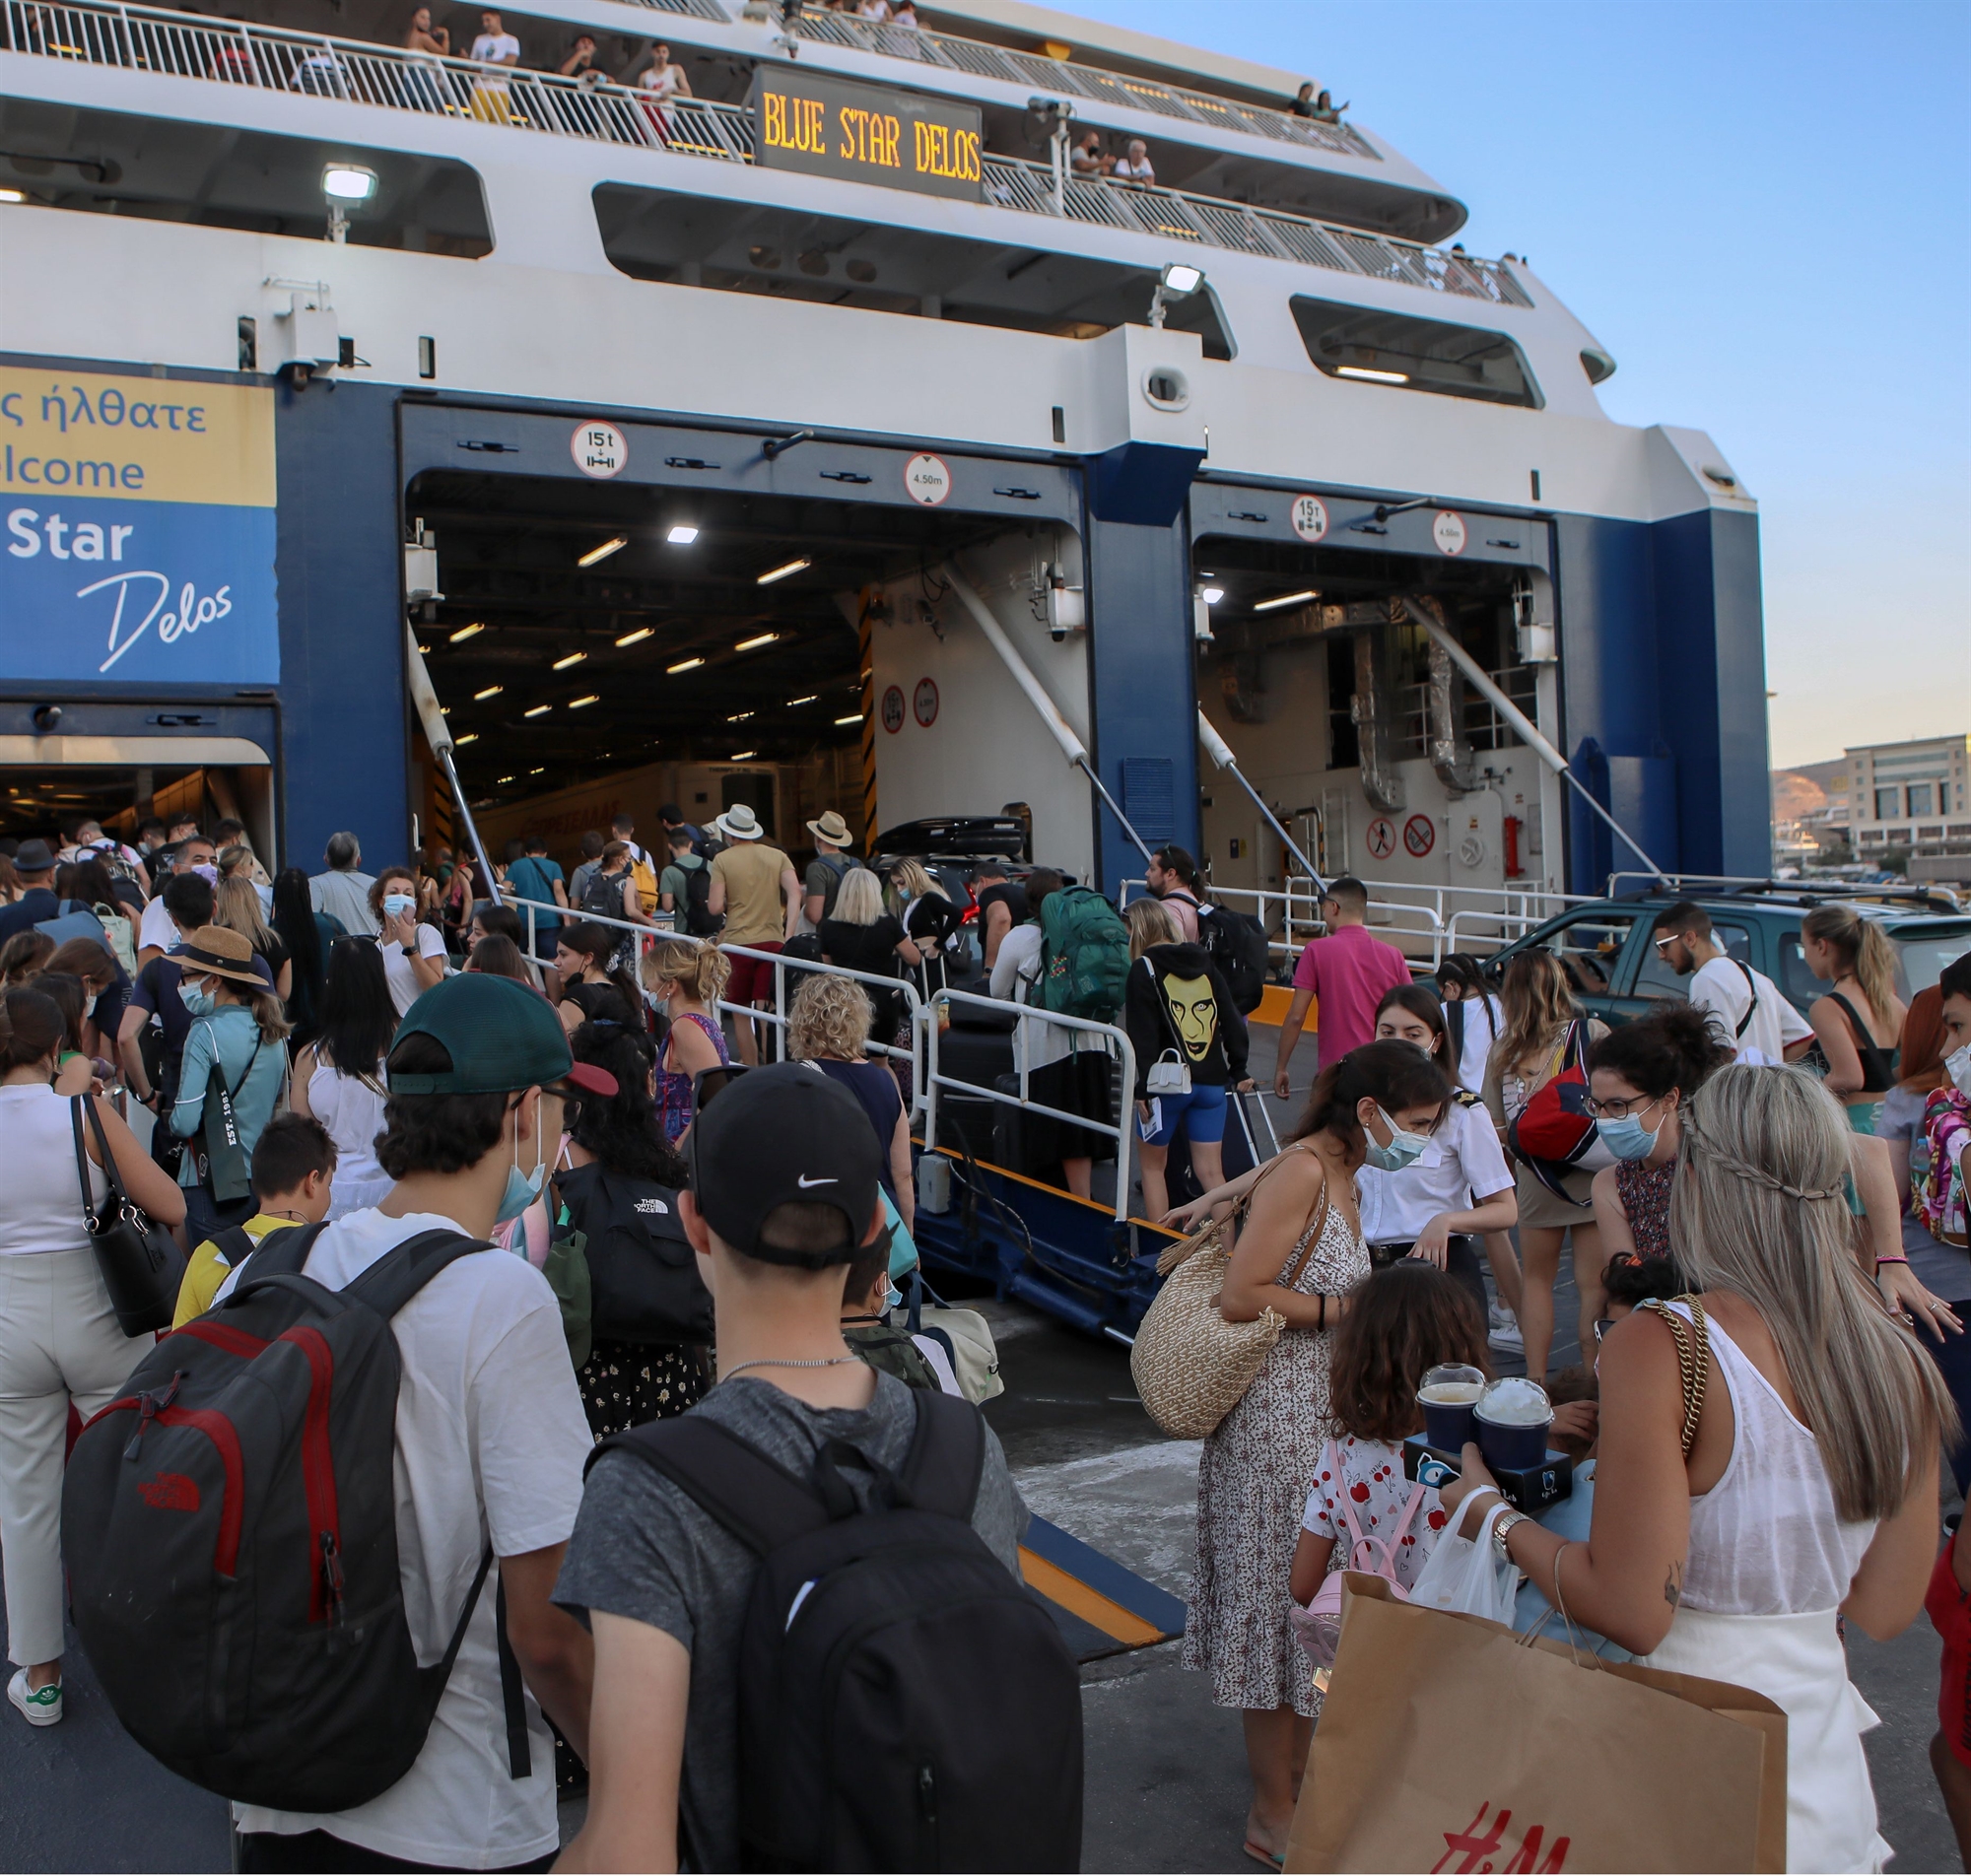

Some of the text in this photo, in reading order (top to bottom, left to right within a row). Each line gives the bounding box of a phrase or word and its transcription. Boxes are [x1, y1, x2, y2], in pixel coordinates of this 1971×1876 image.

[763, 92, 981, 181] BLUE STAR DELOS
[41, 384, 207, 433] ήλθατε
[0, 444, 145, 489] lcome
[914, 474, 943, 485] 4.50m
[7, 507, 134, 562] Star
[76, 570, 233, 674] Delos
[221, 1090, 237, 1146] EST. 1981
